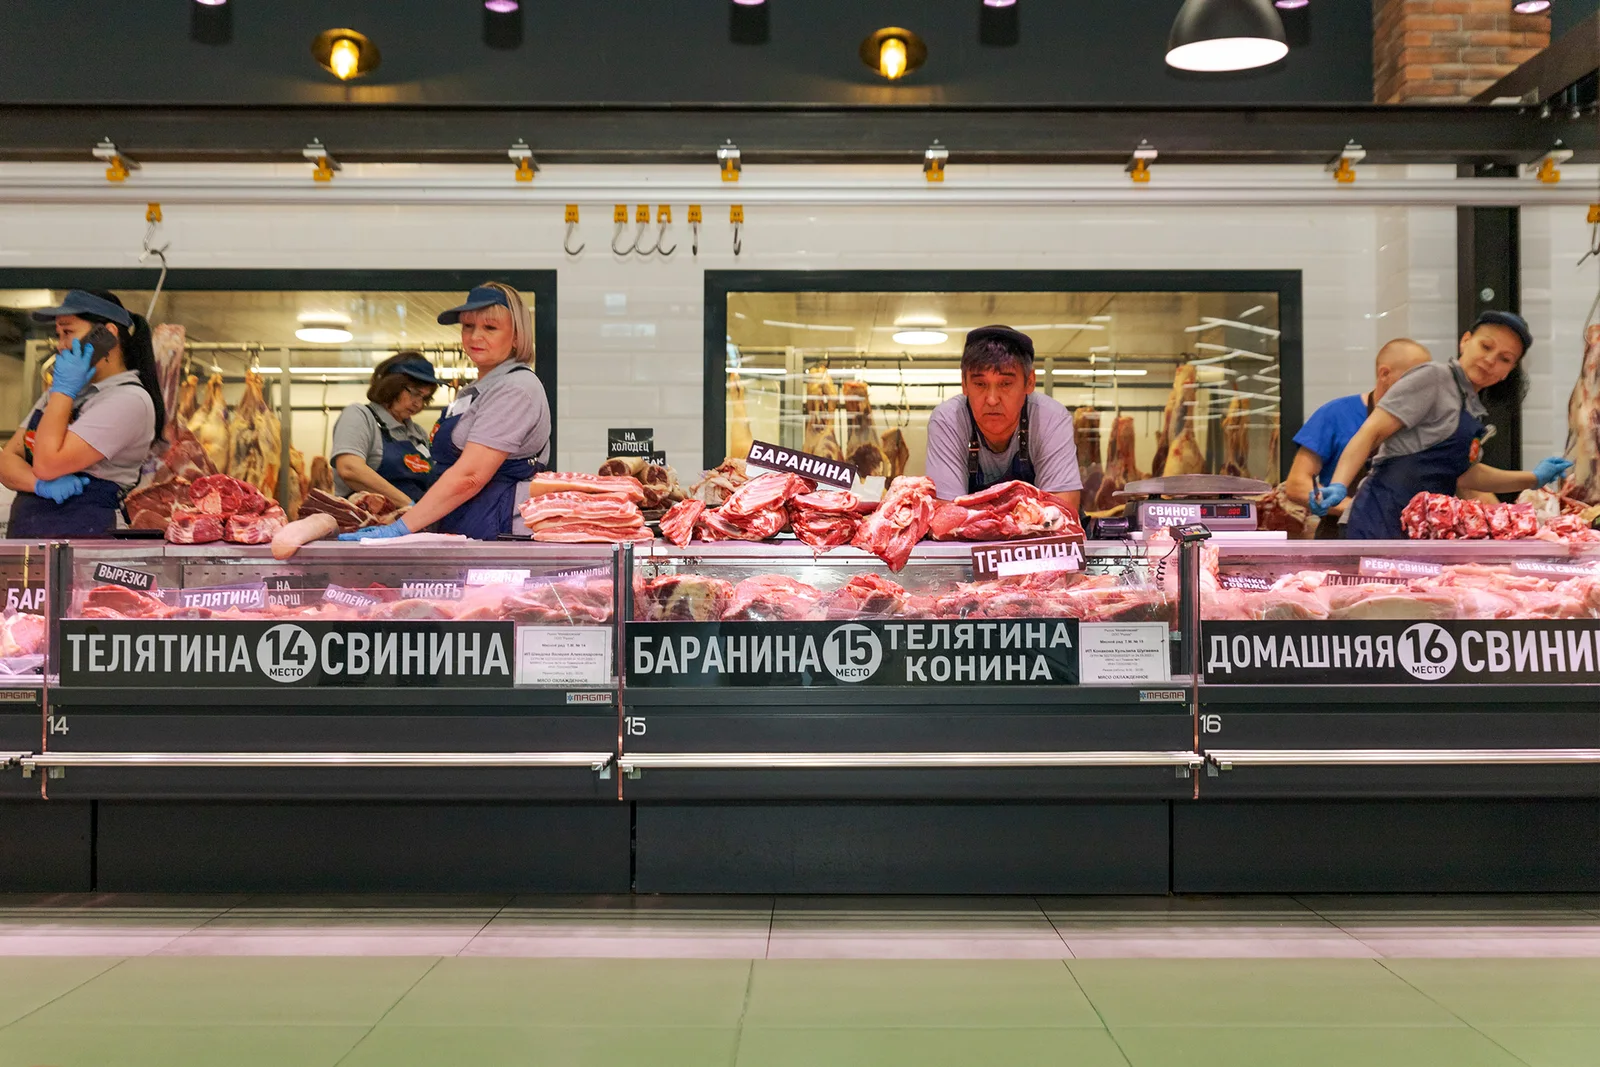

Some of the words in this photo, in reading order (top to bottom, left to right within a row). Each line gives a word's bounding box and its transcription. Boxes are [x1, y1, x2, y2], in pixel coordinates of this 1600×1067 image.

[624, 432, 636, 441] НА
[611, 442, 649, 452] ХОЛОДЕЦ
[750, 444, 852, 484] БАРАНИНА
[1148, 506, 1195, 517] СВИНОЕ
[1158, 517, 1187, 526] РАГУ
[974, 542, 1083, 573] ТЕЛЯТИНА
[98, 564, 148, 588] ВЫРЕЗКА
[1397, 563, 1440, 574] СВИНЫЕ
[276, 580, 290, 591] НА
[402, 581, 462, 599] МЯКОТЬ
[184, 589, 260, 608] ТЕЛЯТИНА
[268, 592, 300, 606] ФАРШ
[884, 622, 1073, 650] ТЕЛЯТИНА
[66, 634, 253, 673] ТЕЛЯТИНА
[265, 630, 309, 666] 14
[320, 631, 510, 676] СВИНИНА
[633, 635, 822, 674] БАРАНИНА
[831, 629, 874, 666] 15
[1207, 635, 1395, 674] ДОМАШНЯЯ
[1405, 628, 1449, 664] 16
[269, 667, 304, 677] МЕСТО
[835, 668, 870, 677] МЕСТО
[906, 654, 1053, 682] КОНИНА
[1412, 665, 1446, 674] МЕСТО
[573, 693, 612, 701] MAGMA
[1146, 691, 1185, 700] MAGMA
[47, 715, 70, 735] 14
[624, 716, 646, 736] 15
[1200, 714, 1221, 733] 16
